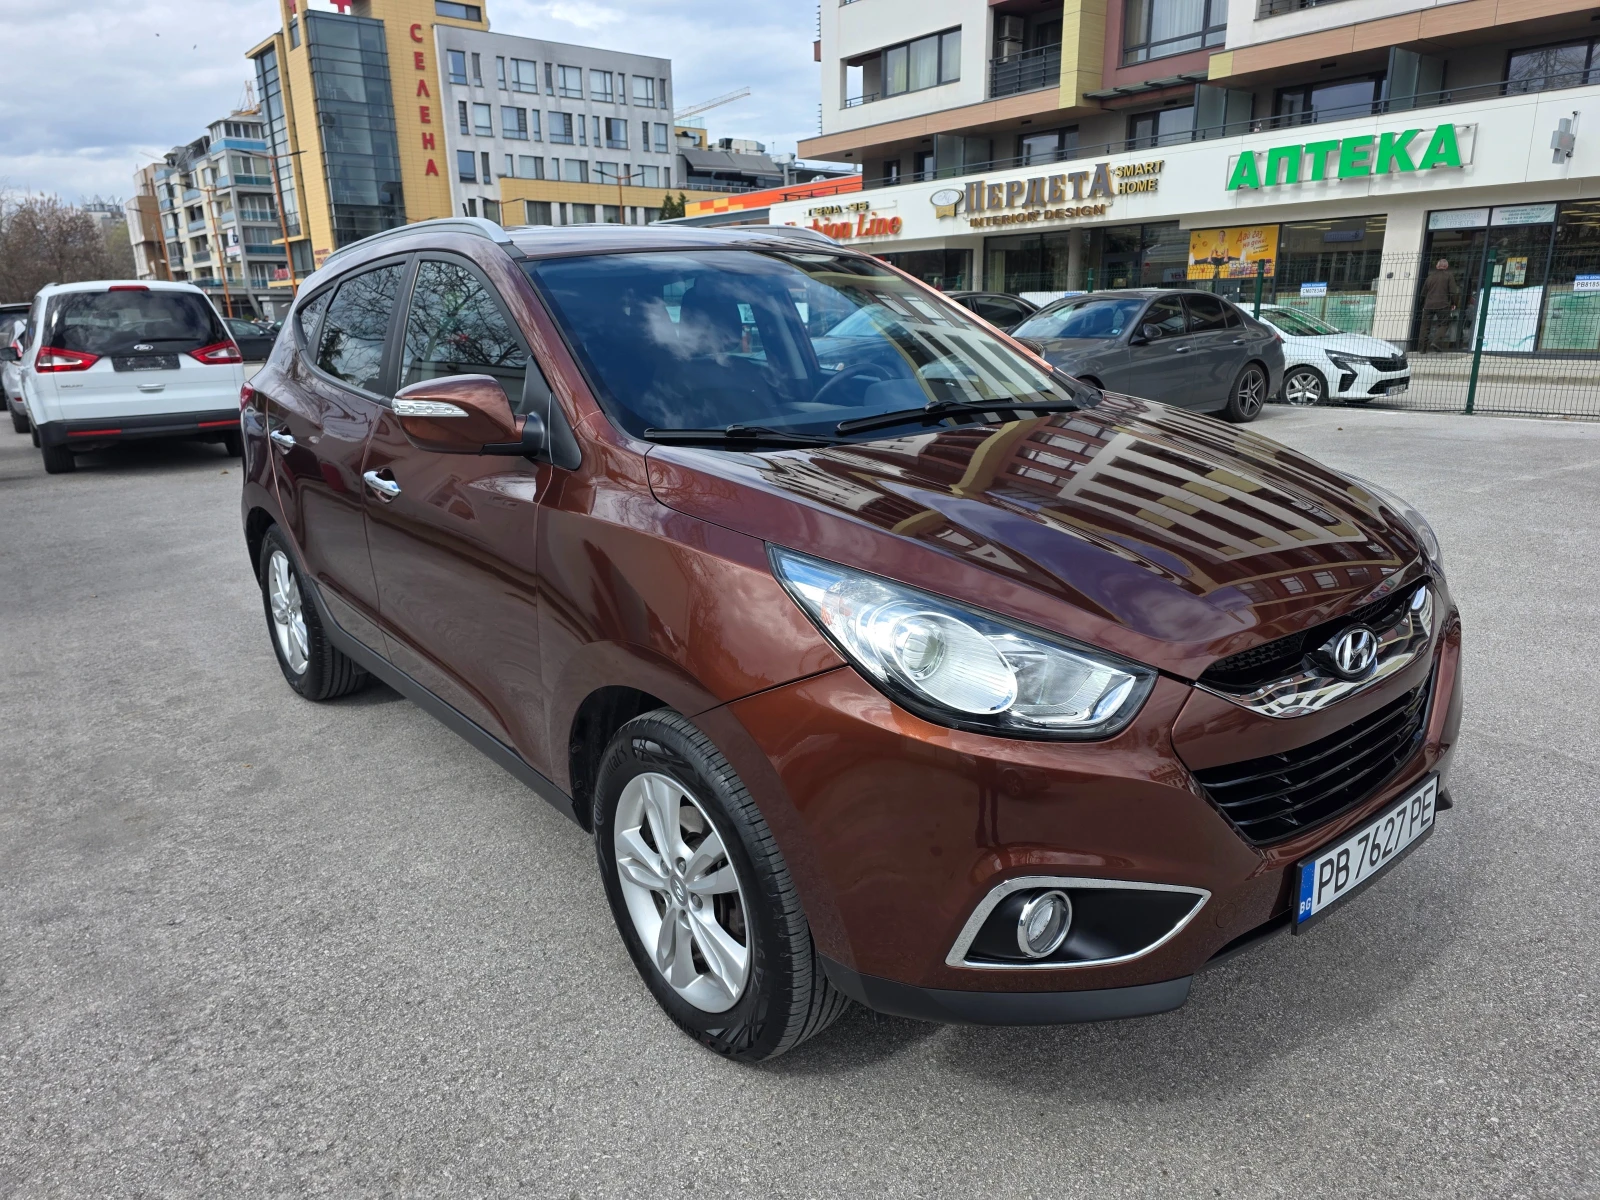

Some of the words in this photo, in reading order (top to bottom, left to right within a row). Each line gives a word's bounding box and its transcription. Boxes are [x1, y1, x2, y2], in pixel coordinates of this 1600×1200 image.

[409, 23, 439, 177] СЕЛЕНА
[1115, 159, 1165, 178] SMART
[1227, 123, 1461, 191] АПТЕКА
[964, 162, 1115, 213] ПЕРДЕТА
[1117, 178, 1159, 195] HOME
[856, 211, 903, 237] Line
[969, 211, 1040, 228] INTERIOR
[1044, 203, 1107, 221] DESIGN
[1317, 847, 1351, 905] PB
[1355, 805, 1408, 880] 7627
[1408, 784, 1434, 838] PE
[1300, 897, 1312, 915] BG
